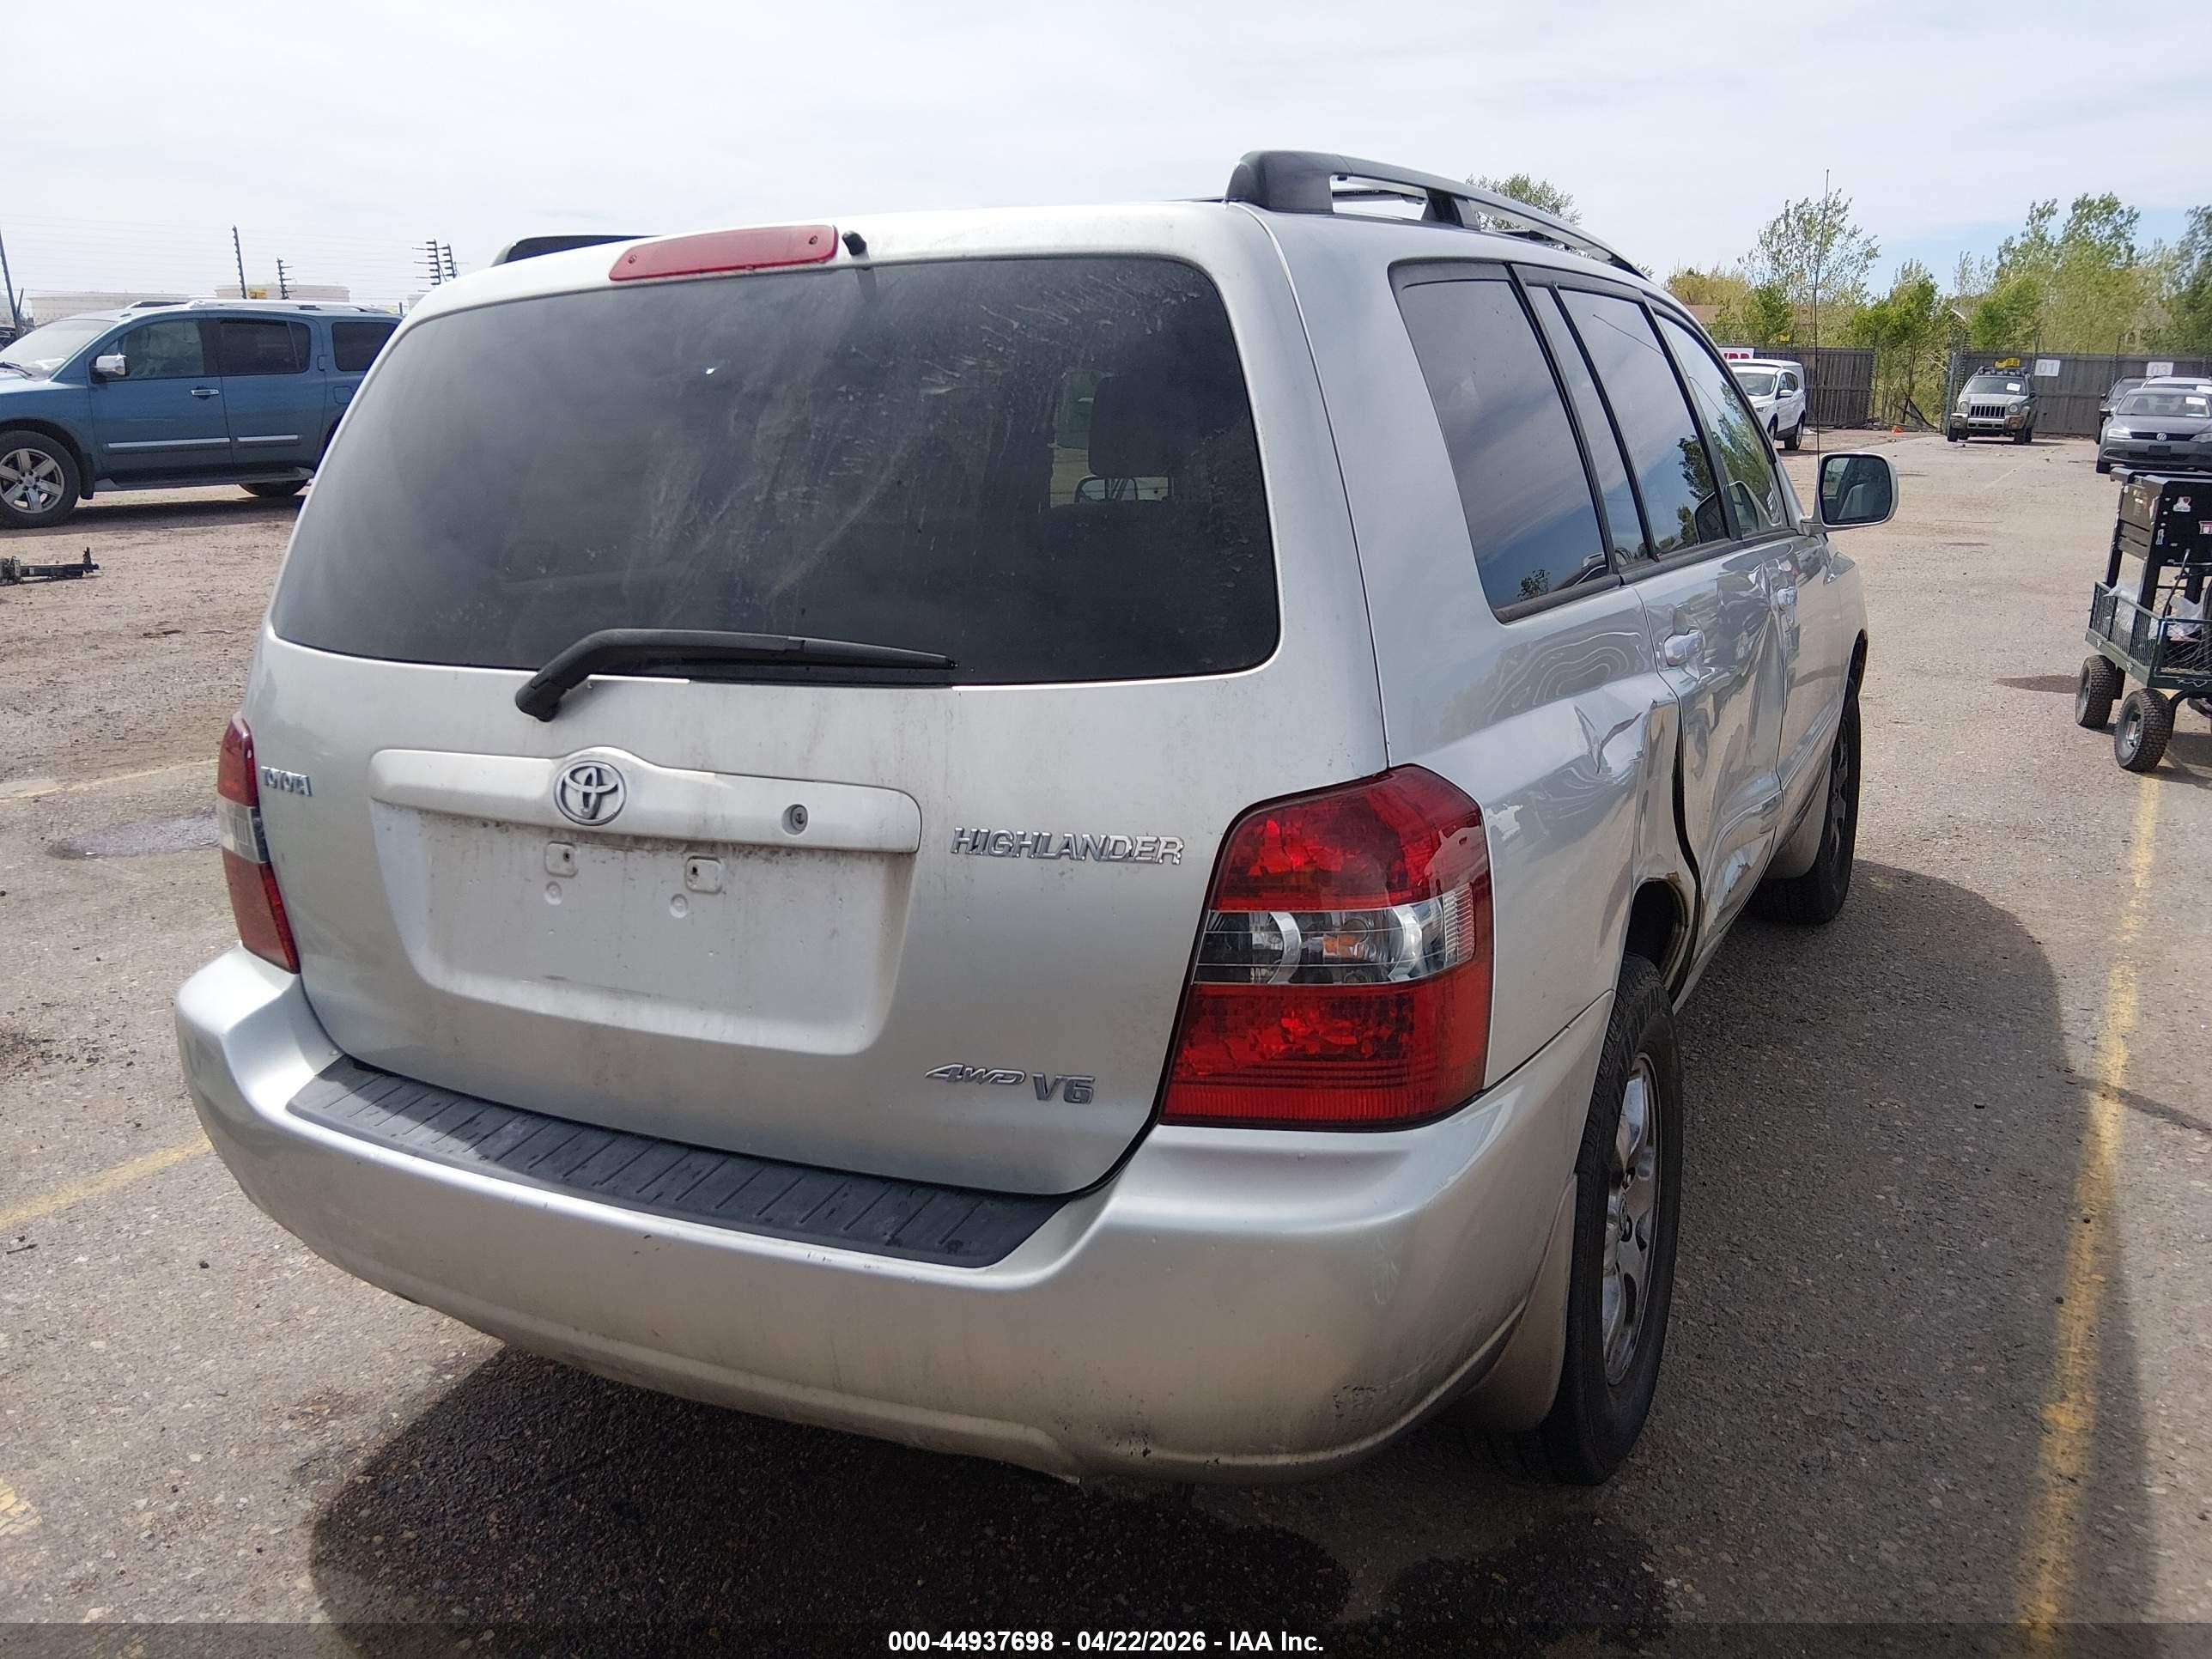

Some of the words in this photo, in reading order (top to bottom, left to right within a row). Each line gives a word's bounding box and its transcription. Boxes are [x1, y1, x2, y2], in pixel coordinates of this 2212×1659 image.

[950, 826, 1185, 866] HIGHLANDER
[925, 1062, 1026, 1085] 4WD
[1031, 1072, 1096, 1105] V6
